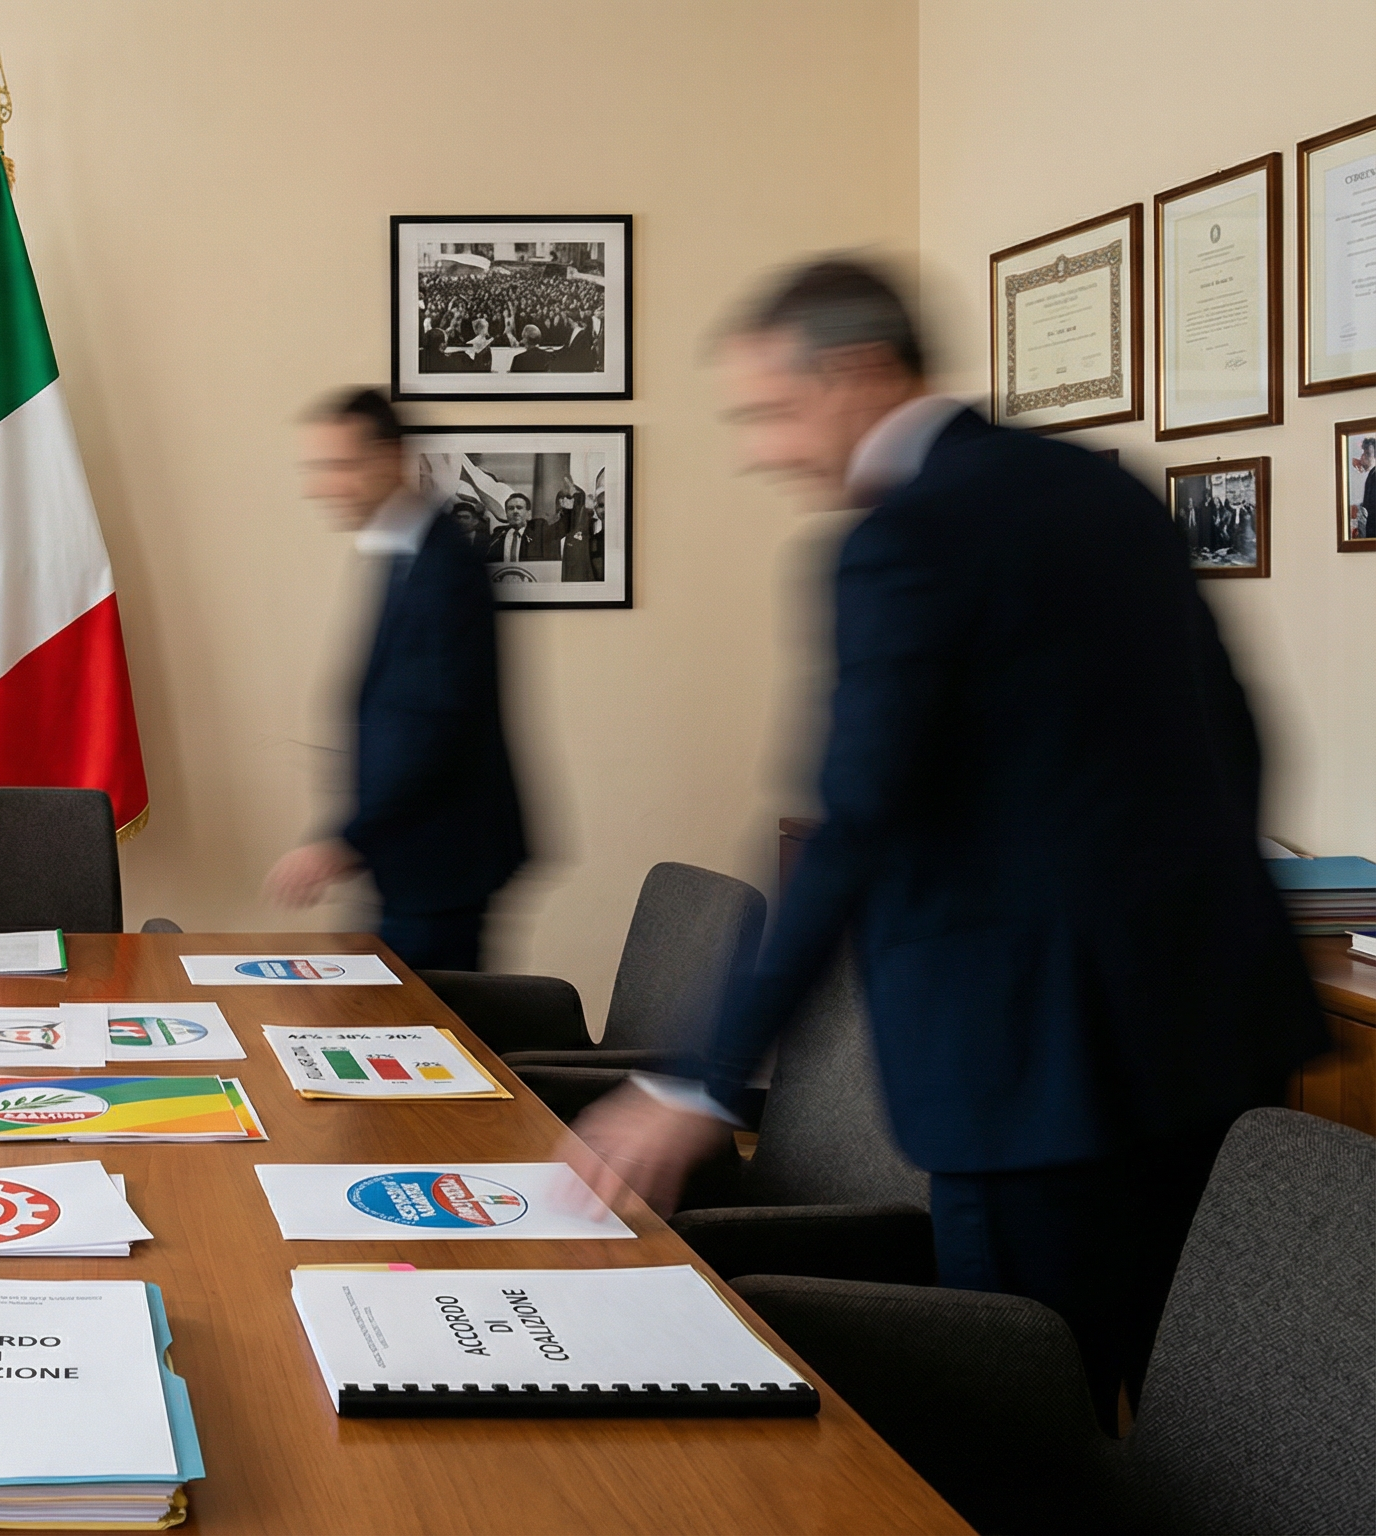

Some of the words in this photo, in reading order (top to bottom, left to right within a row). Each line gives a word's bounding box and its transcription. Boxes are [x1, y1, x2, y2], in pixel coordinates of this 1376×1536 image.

[434, 1295, 492, 1357] ACCORDO
[484, 1319, 514, 1333] DI
[501, 1288, 570, 1362] COALIZIONE
